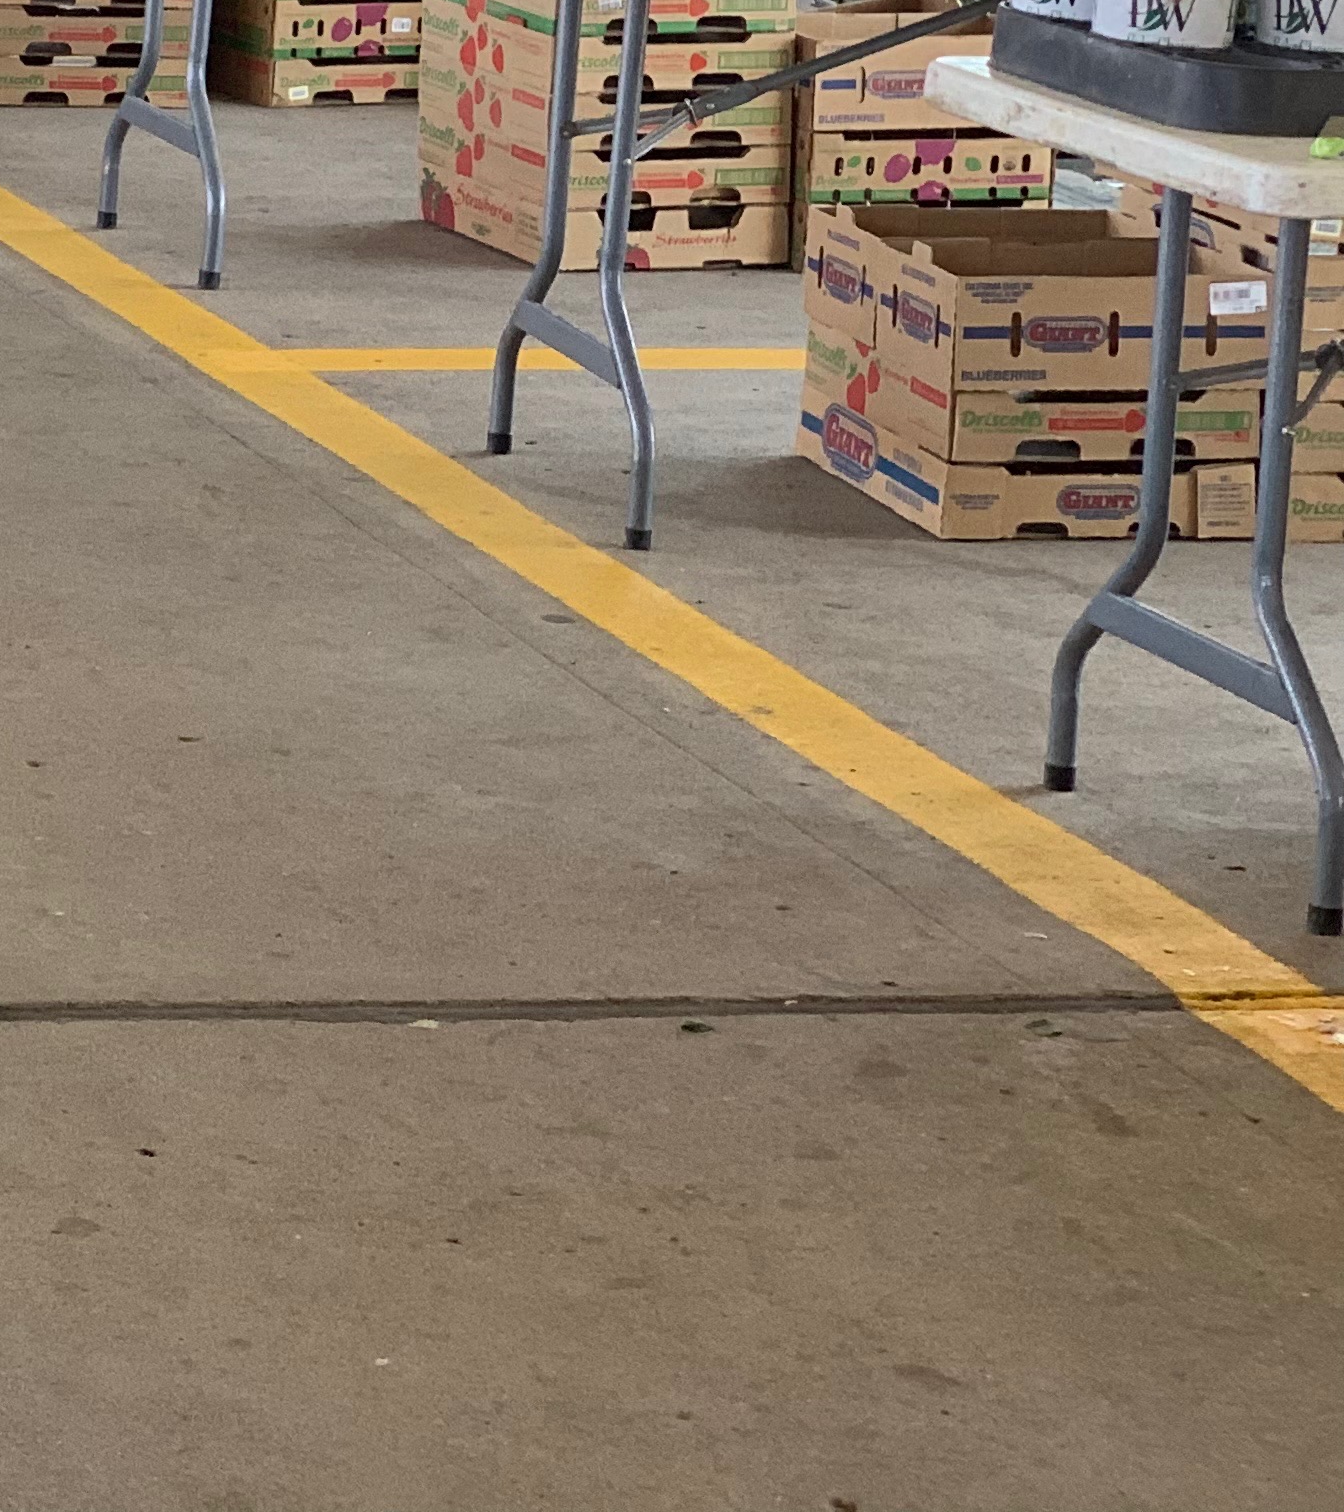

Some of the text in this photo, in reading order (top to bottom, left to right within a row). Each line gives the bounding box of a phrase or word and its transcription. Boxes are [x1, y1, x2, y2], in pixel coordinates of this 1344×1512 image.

[818, 113, 885, 124] BLUEBERRIES
[453, 182, 513, 225] Strawberries
[652, 233, 737, 249] Strawberries
[825, 259, 857, 294] GIANT
[900, 296, 934, 333] GIANT
[1029, 322, 1102, 343] GIANT
[961, 369, 1047, 382] BLUEBERRIES
[961, 409, 1042, 429] Driscoll's
[826, 413, 874, 470] GIANT
[1062, 489, 1135, 510] GIANT
